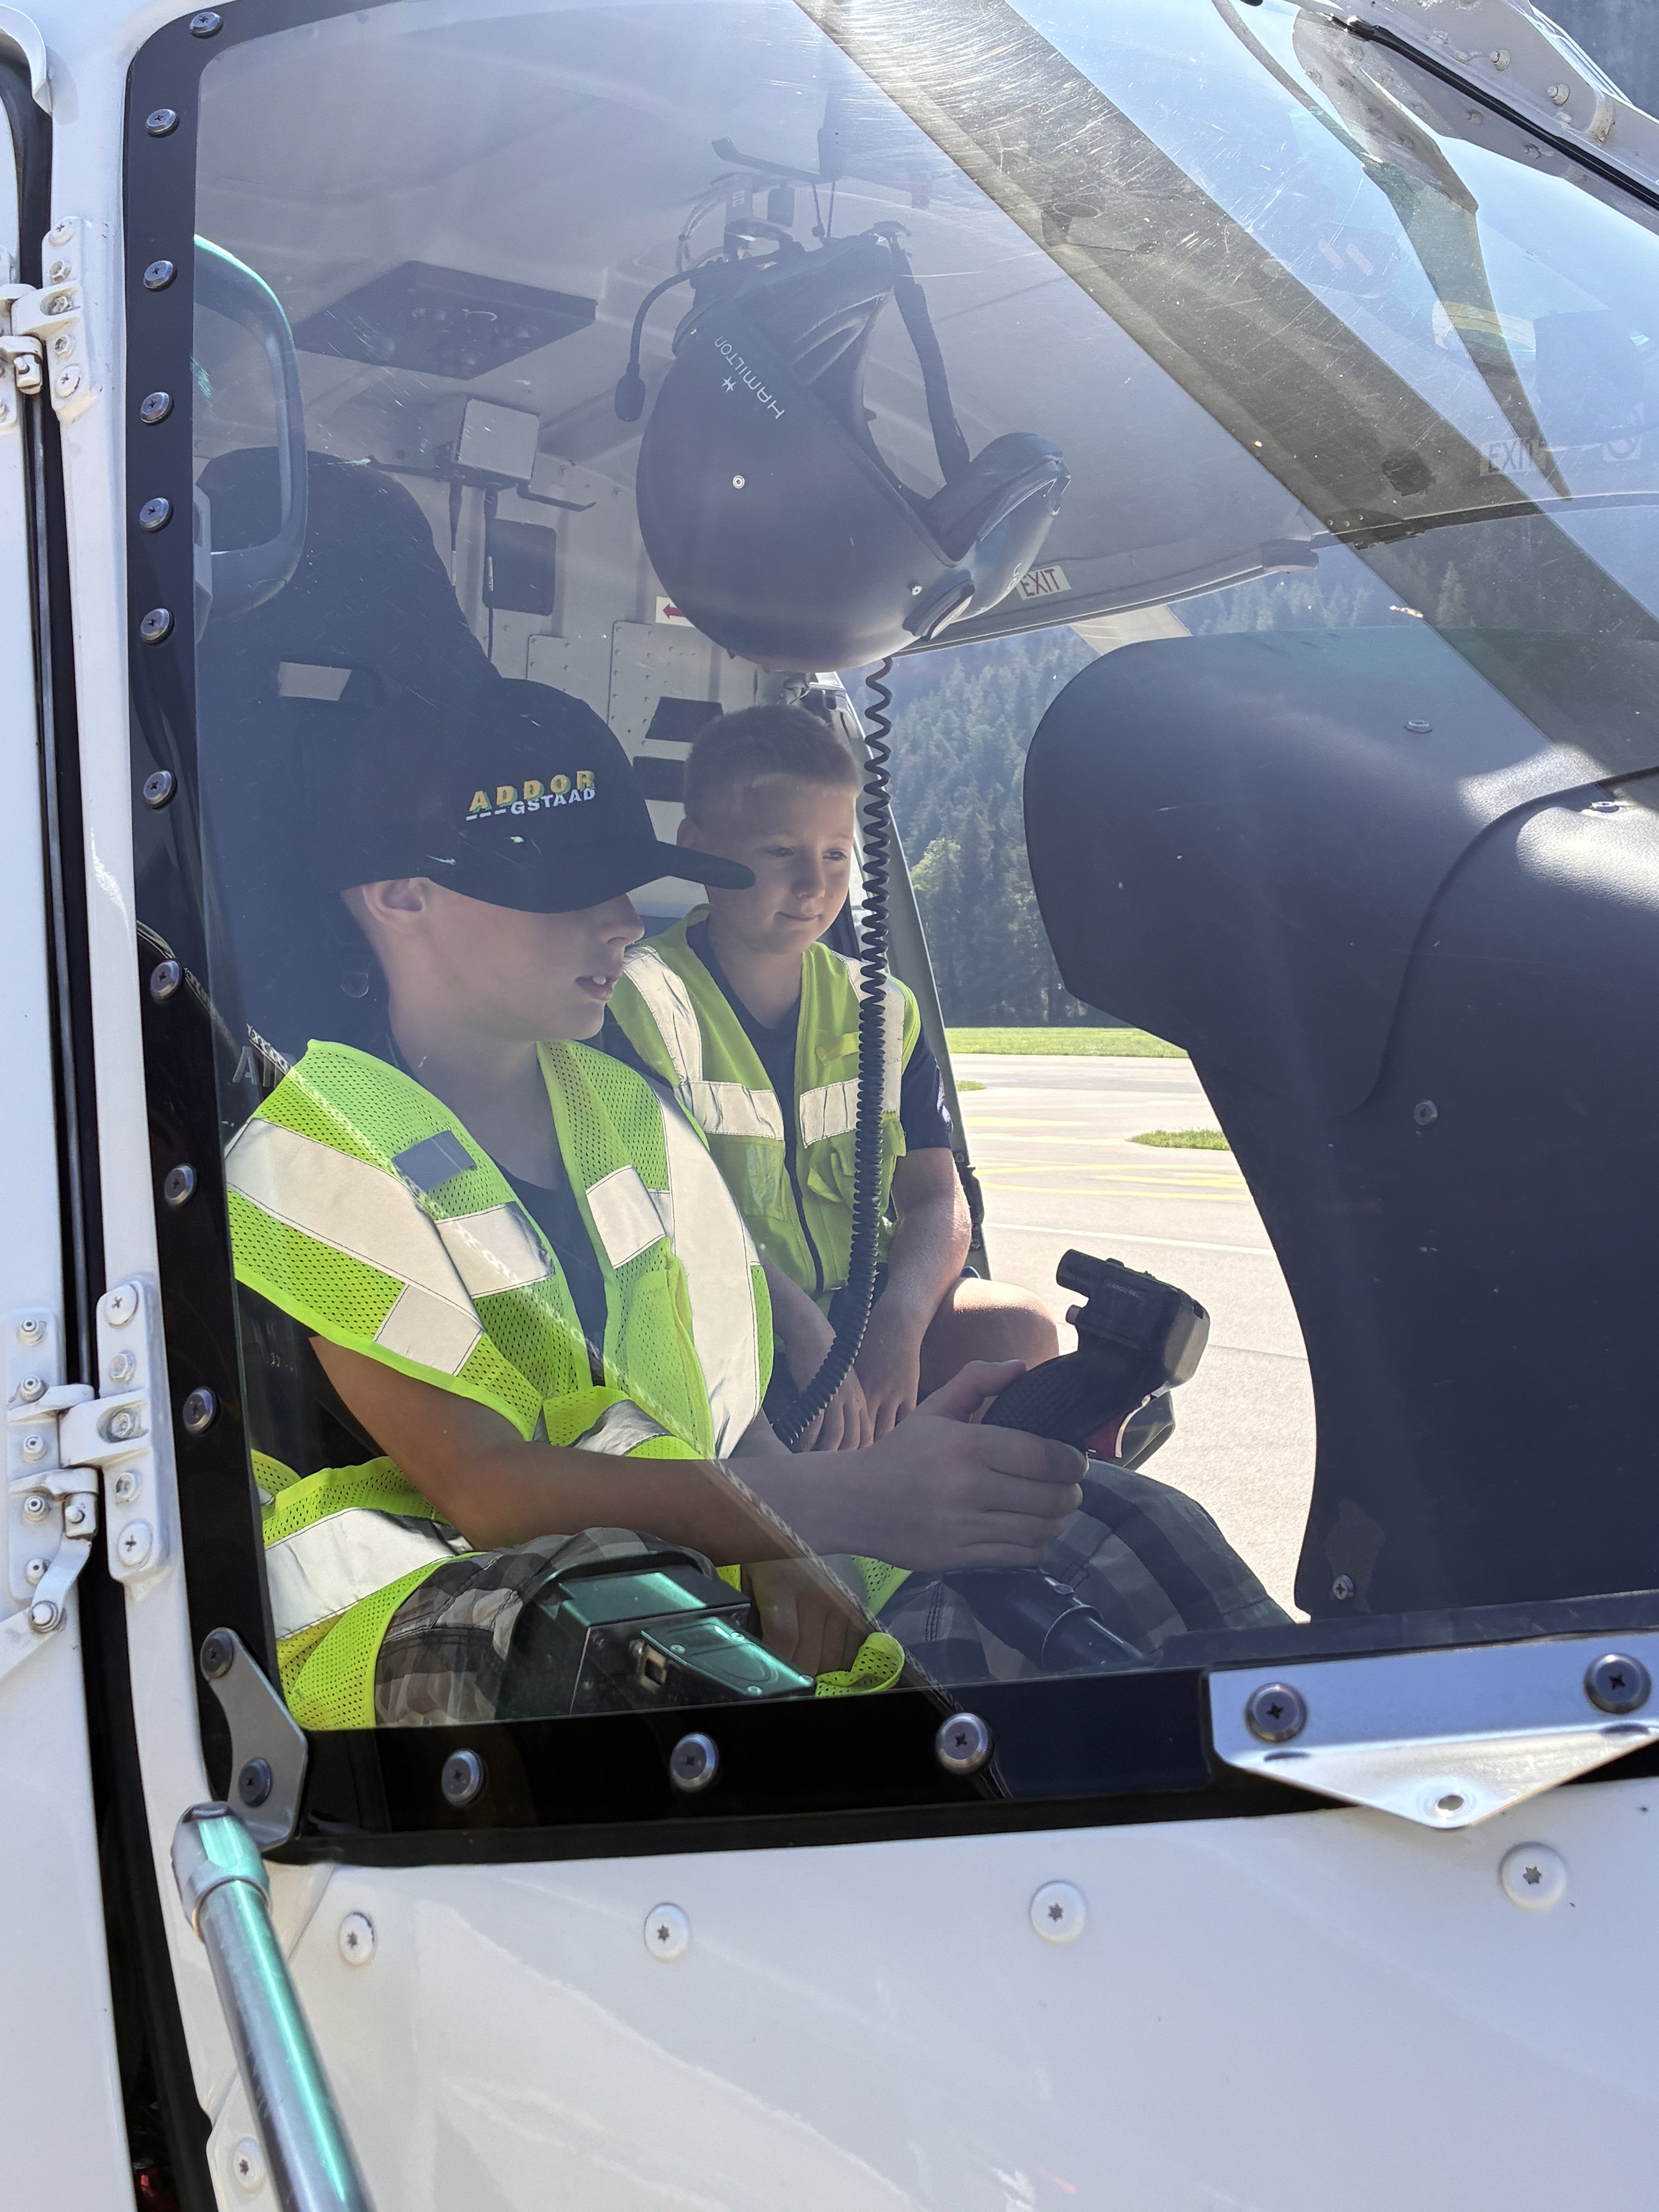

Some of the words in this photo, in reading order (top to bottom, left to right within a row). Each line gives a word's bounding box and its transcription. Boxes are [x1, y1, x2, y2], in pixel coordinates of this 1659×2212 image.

[714, 335, 785, 419] HAMILTON
[1020, 568, 1060, 597] EXIT
[469, 770, 596, 813] ADDOR
[510, 787, 596, 815] GSTAAD
